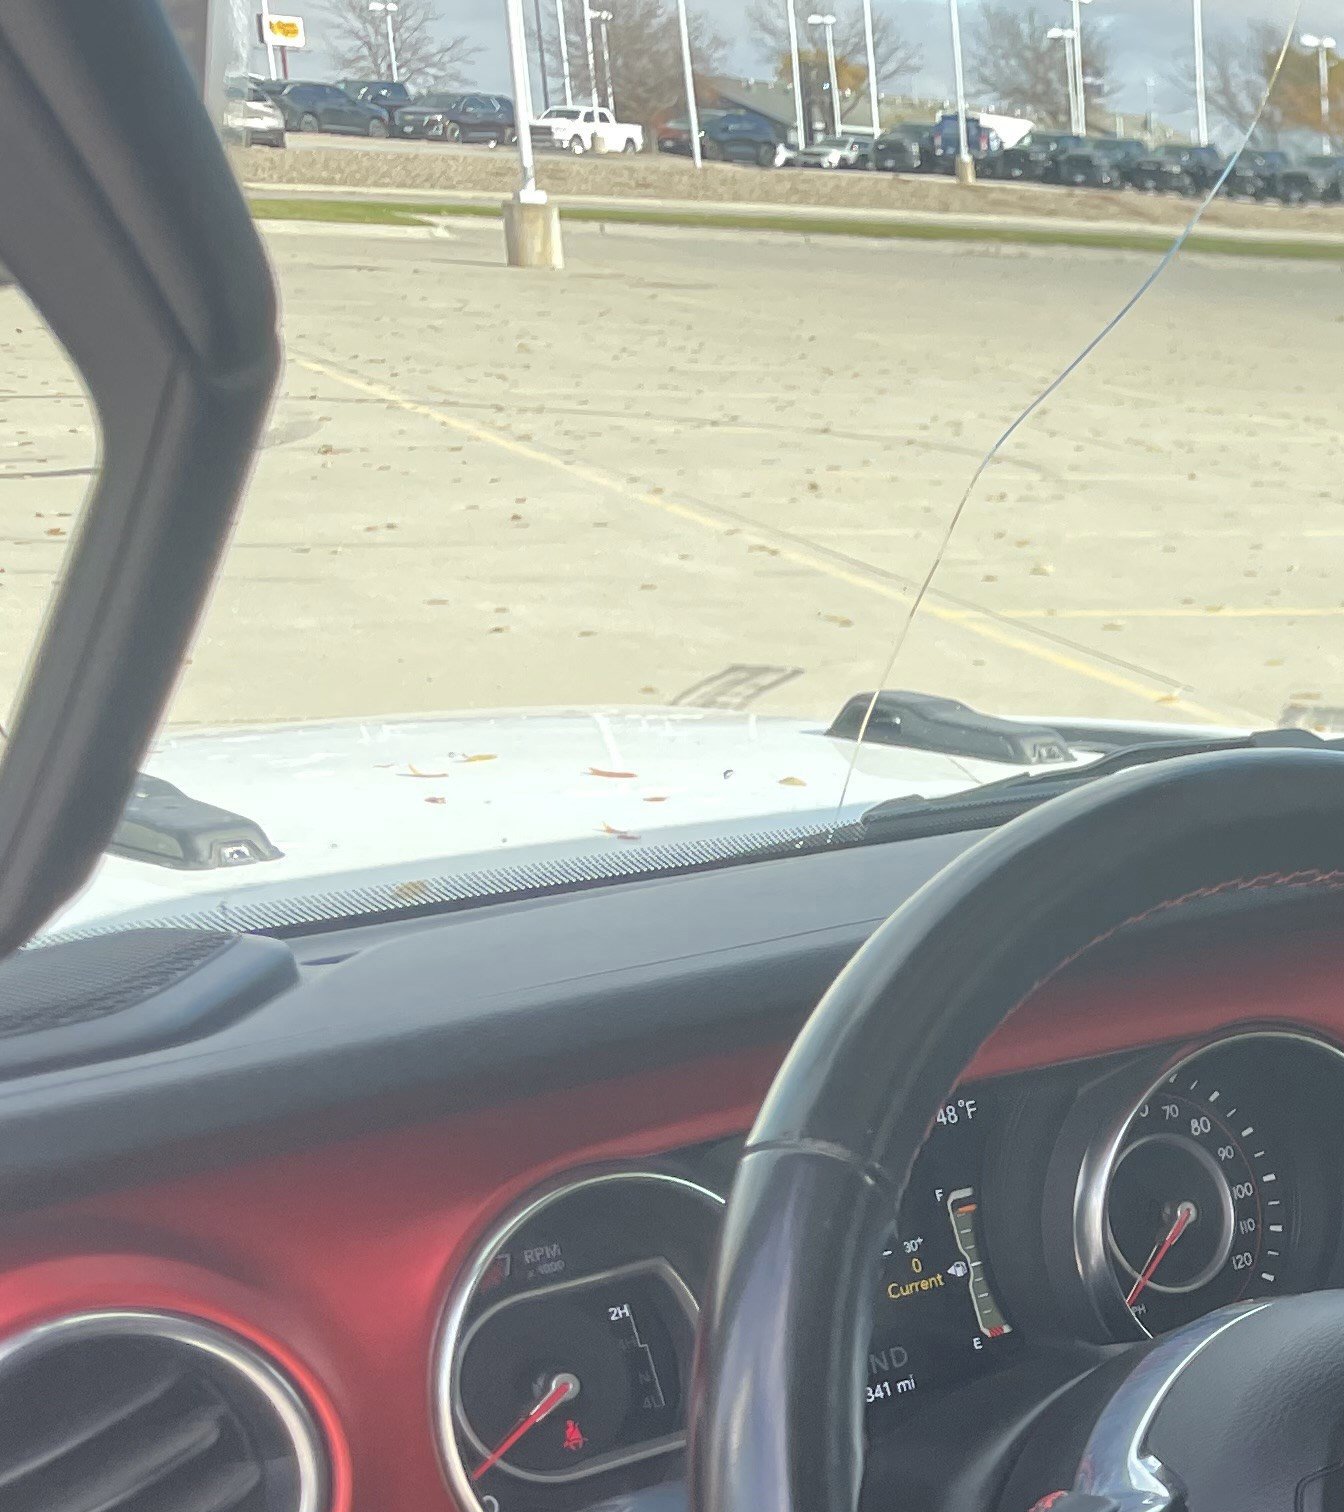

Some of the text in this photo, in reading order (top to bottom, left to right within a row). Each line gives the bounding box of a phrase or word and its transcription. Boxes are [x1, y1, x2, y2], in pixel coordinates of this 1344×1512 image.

[1161, 1104, 1180, 1121] 70
[1190, 1116, 1211, 1137] 80
[1217, 1145, 1235, 1162] 90
[1232, 1182, 1254, 1201] 100
[1231, 1251, 1253, 1271] 120
[887, 1272, 945, 1299] Current
[608, 1304, 630, 1321] 2H
[896, 1374, 916, 1394] mi
